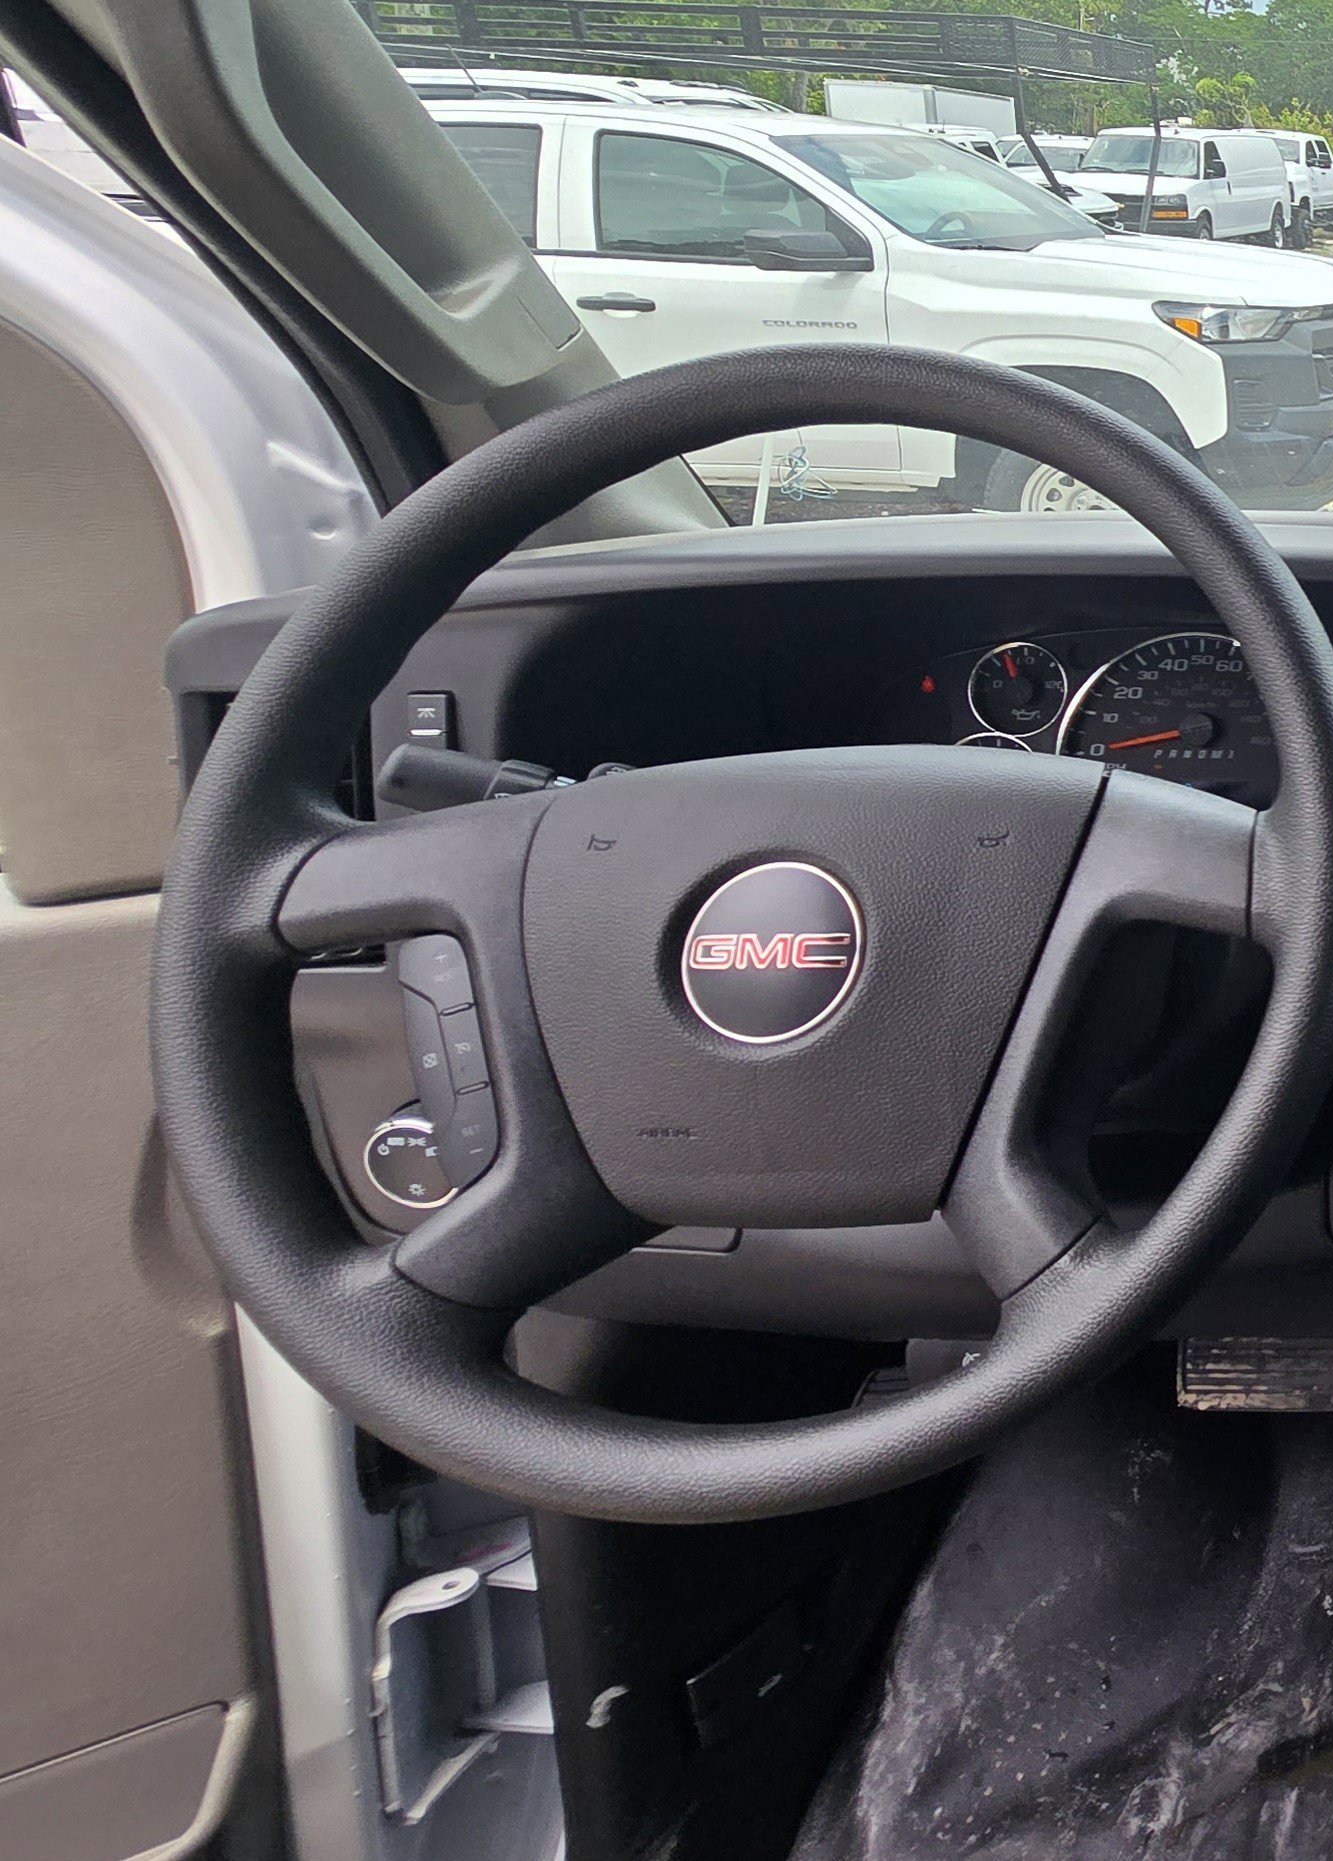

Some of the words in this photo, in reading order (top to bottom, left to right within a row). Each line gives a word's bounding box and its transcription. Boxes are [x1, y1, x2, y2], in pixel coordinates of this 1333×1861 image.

[762, 319, 858, 330] COLORADO
[1157, 658, 1189, 672] 40
[1190, 654, 1215, 666] 50
[1214, 659, 1244, 673] 60
[1136, 670, 1159, 681] 30
[1112, 686, 1144, 700] 20
[1102, 711, 1120, 724] 10
[1088, 743, 1106, 757] 0
[689, 933, 851, 970] GMC
